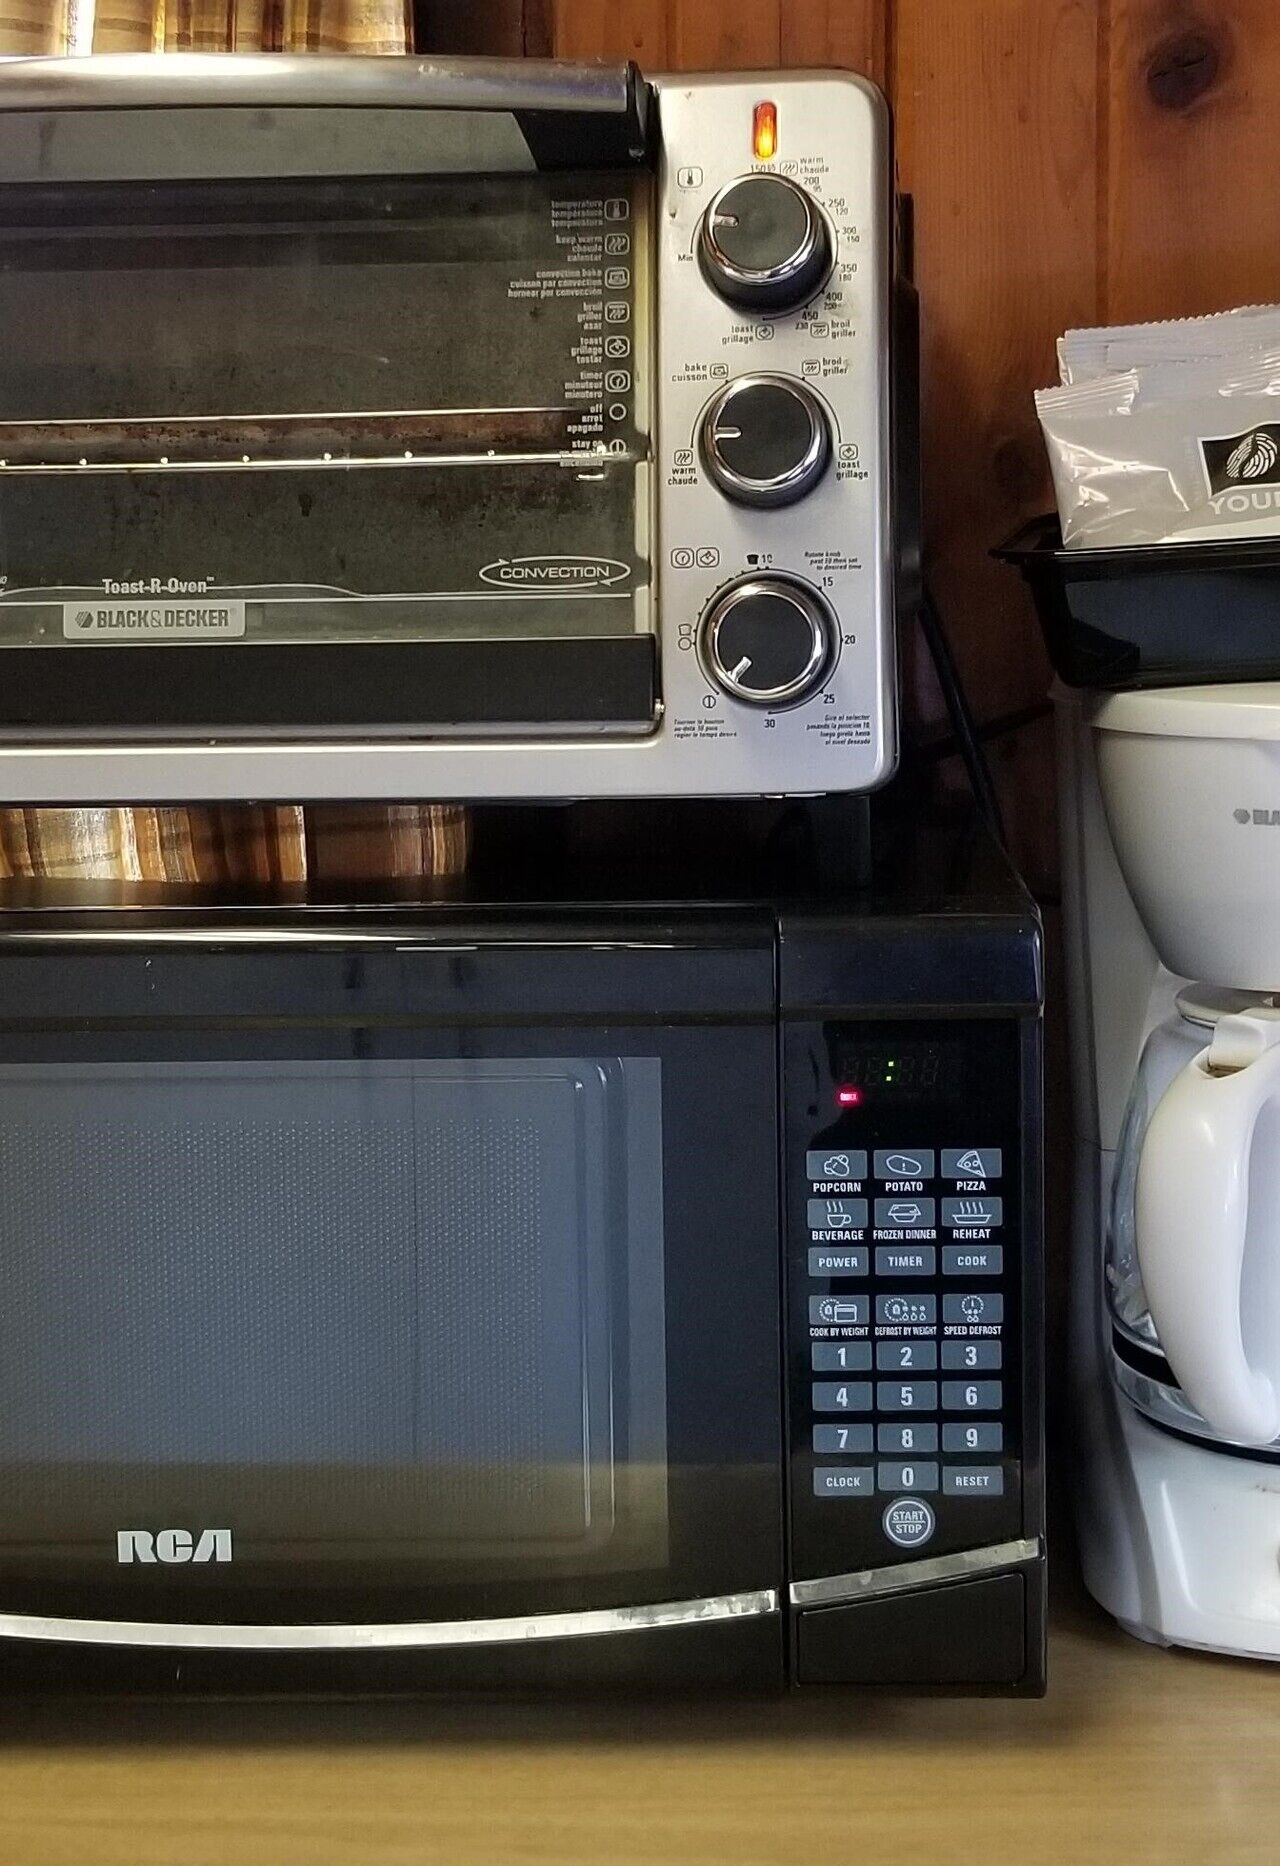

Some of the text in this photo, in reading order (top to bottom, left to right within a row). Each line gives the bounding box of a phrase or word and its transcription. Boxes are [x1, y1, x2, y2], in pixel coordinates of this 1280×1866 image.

[804, 176, 820, 184] 200
[828, 198, 845, 208] 250
[836, 208, 848, 216] 120
[842, 226, 857, 234] 300
[841, 264, 858, 272] 350
[510, 278, 541, 288] cuisson
[826, 292, 842, 301] 400
[802, 312, 818, 320] 450
[831, 320, 850, 328] broil
[731, 325, 754, 334] toast
[831, 330, 856, 339] griller
[722, 335, 754, 345] grillage
[822, 358, 842, 366] broil
[685, 364, 708, 372] bake
[822, 366, 848, 376] griller
[580, 372, 602, 380] timer
[672, 374, 708, 382] cuisson
[590, 404, 603, 414] off
[566, 422, 604, 434] apagado
[572, 440, 592, 450] stay
[837, 461, 860, 469] toast
[836, 470, 868, 481] grillage
[668, 477, 698, 486] chaude
[762, 554, 773, 564] 10
[500, 566, 610, 579] CONVECTION
[822, 576, 834, 586] 15
[96, 609, 228, 628] BLACK&DECKER
[844, 635, 856, 645] 20
[824, 694, 835, 704] 25
[764, 720, 776, 728] 30
[813, 1182, 862, 1192] POPCORN
[885, 1182, 924, 1192] POTATO
[956, 1180, 986, 1191] PIZZA
[812, 1230, 864, 1240] BEVERAGE
[873, 1229, 936, 1240] FROZEN DINNER
[952, 1228, 991, 1239] REHEAT
[818, 1257, 858, 1267] POWER
[888, 1256, 922, 1266] TIMER
[957, 1256, 987, 1266] COOK
[810, 1326, 869, 1336] COOK BY WEIGHT
[875, 1326, 937, 1336] DEFROST BY WEIGHT
[944, 1326, 1002, 1335] SPEED DEFROST
[838, 1348, 846, 1368] 1
[900, 1346, 912, 1366] 2
[965, 1346, 977, 1366] 3
[836, 1388, 848, 1408] 4
[900, 1386, 913, 1406] 5
[966, 1386, 978, 1406] 6
[838, 1429, 848, 1448] 7
[901, 1428, 914, 1448] 8
[966, 1428, 978, 1448] 9
[902, 1467, 914, 1486] 0
[955, 1476, 990, 1486] RESET
[826, 1477, 860, 1487] CLOCK
[892, 1511, 924, 1521] START
[895, 1524, 923, 1534] STOP
[117, 1529, 232, 1563] RCA
